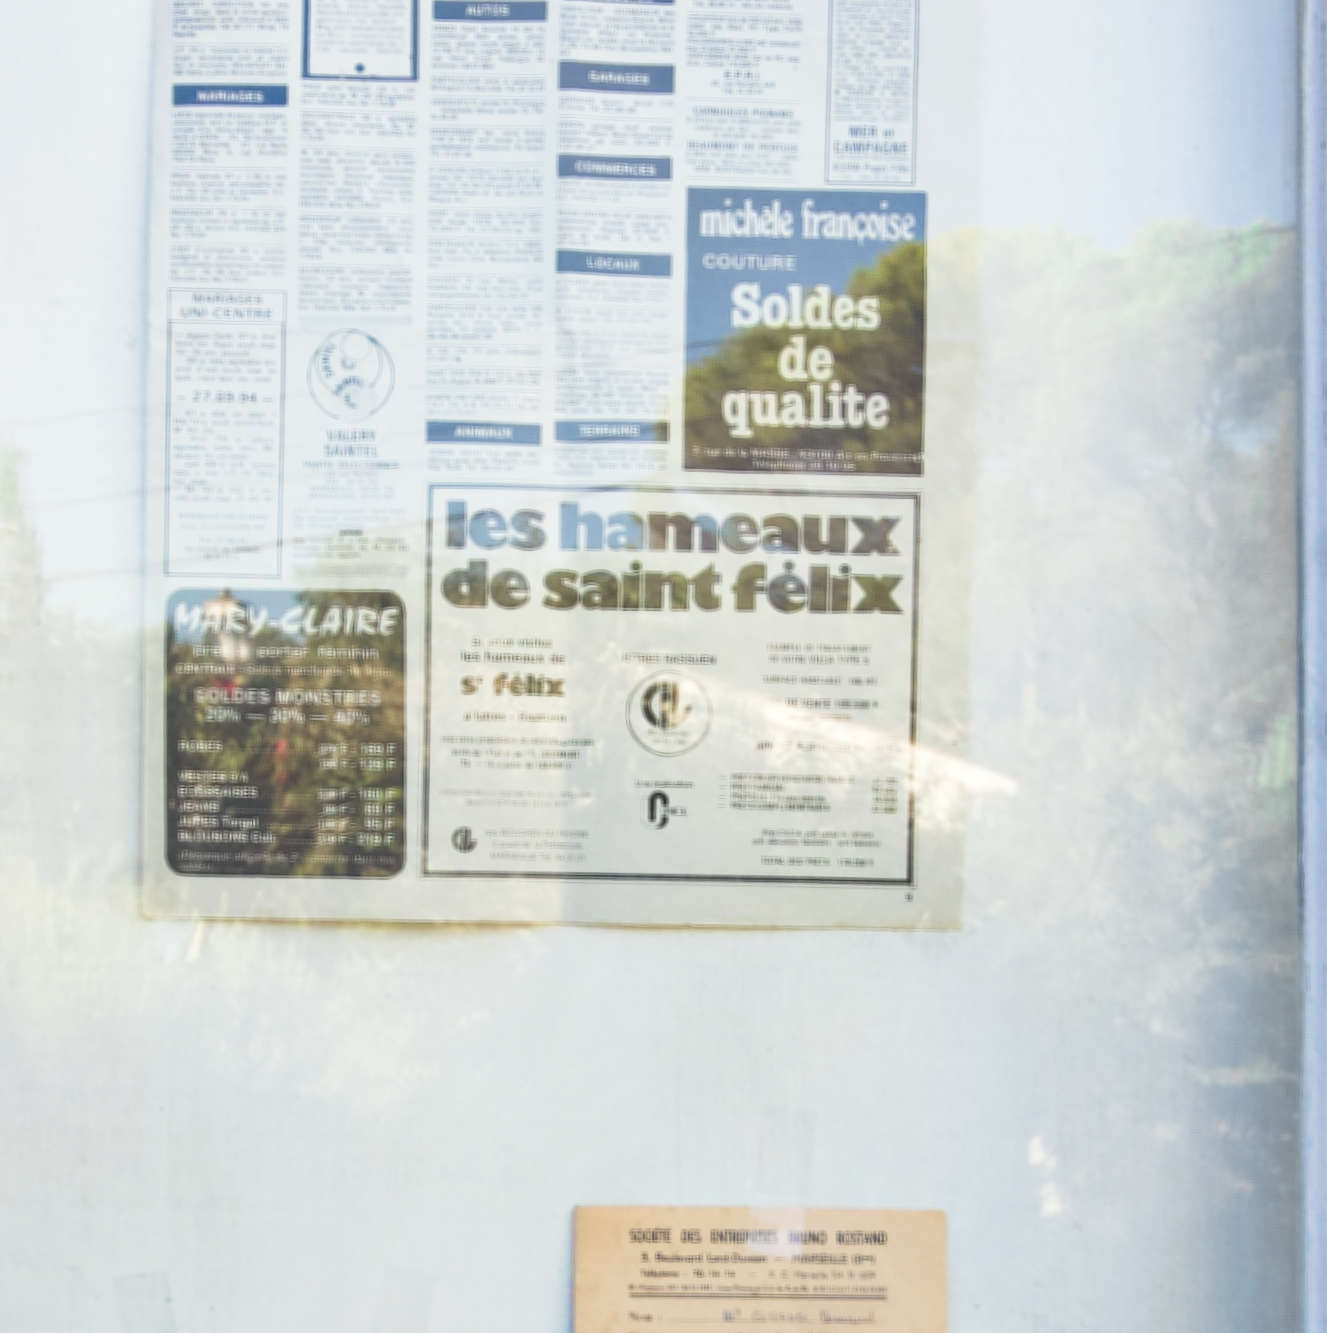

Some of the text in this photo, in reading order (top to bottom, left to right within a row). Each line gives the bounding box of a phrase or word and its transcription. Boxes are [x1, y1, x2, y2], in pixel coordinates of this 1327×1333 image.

[699, 198, 795, 239] michèle
[801, 198, 917, 243] françoise
[702, 251, 800, 272] COUTURE
[730, 281, 881, 331] Soldes
[778, 333, 835, 382] de
[721, 382, 891, 439] qualite
[443, 500, 546, 551] les
[560, 501, 901, 557] hameaux
[440, 558, 532, 611] de
[541, 558, 720, 614] saint
[174, 603, 401, 636] MARY-CLAIRE
[193, 687, 382, 706] SOLDES MONSTRES
